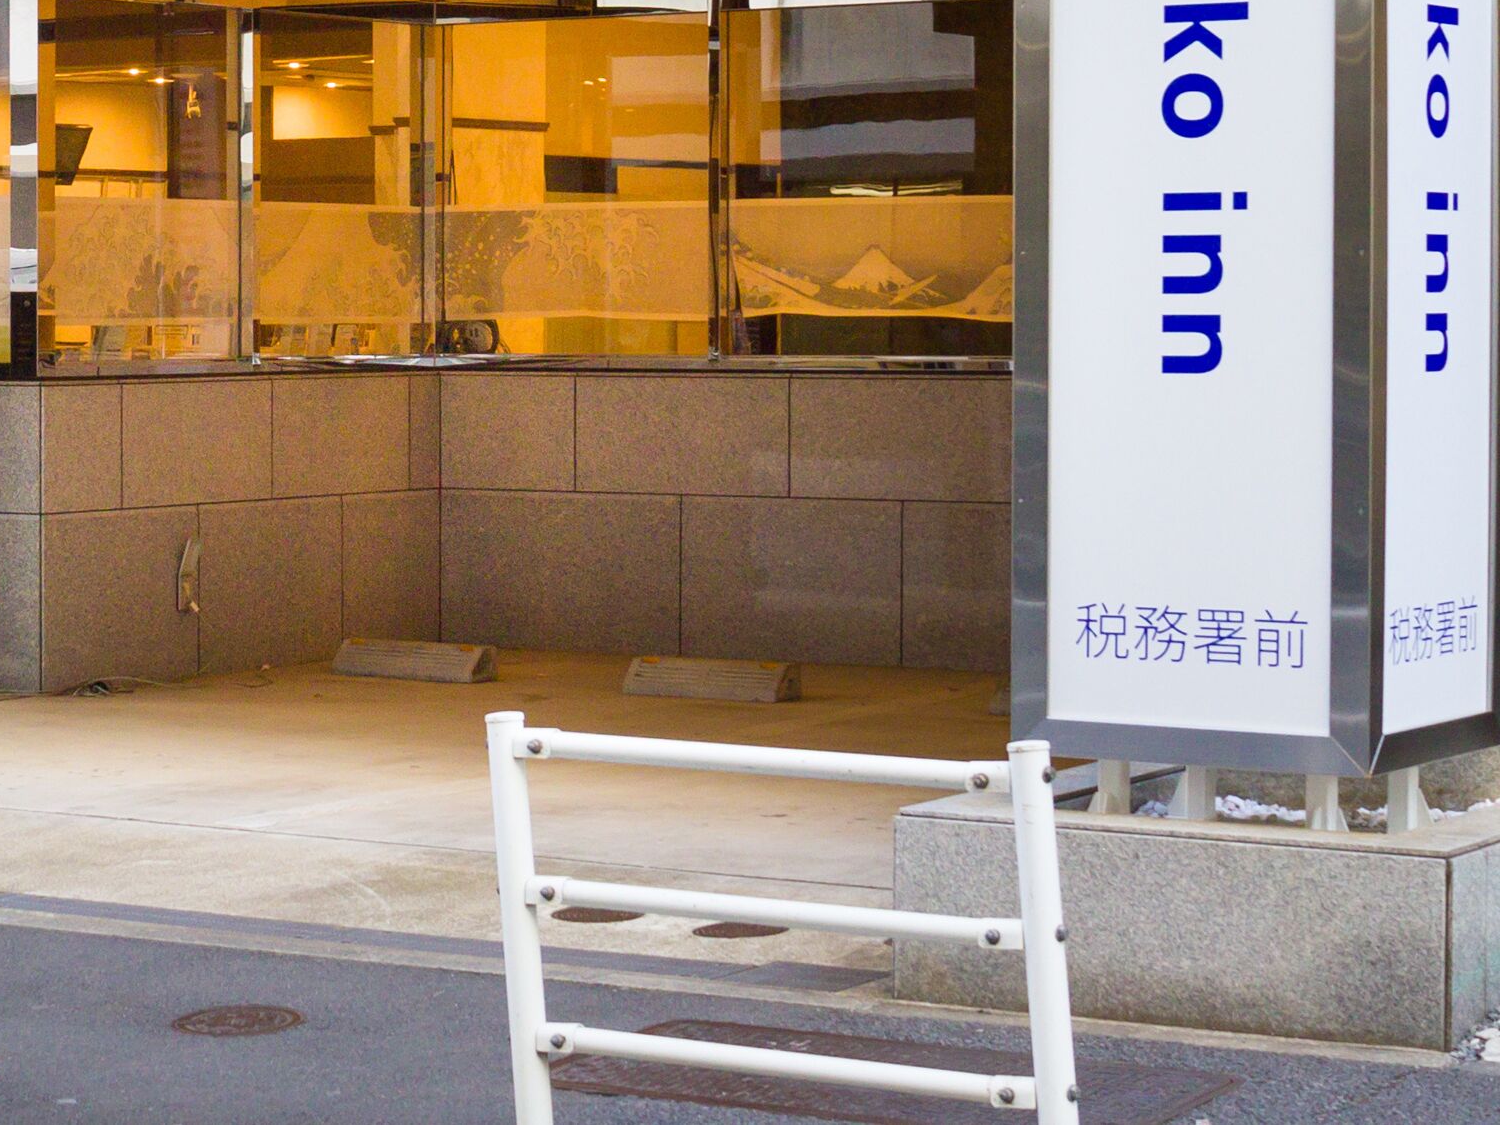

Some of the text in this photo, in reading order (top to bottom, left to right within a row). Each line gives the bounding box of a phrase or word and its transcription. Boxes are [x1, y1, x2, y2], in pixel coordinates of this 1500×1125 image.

[1161, 191, 1250, 376] inn
[1425, 191, 1461, 375] inn
[1075, 602, 1310, 670] 税務署前
[1388, 595, 1479, 667] 税務署前
